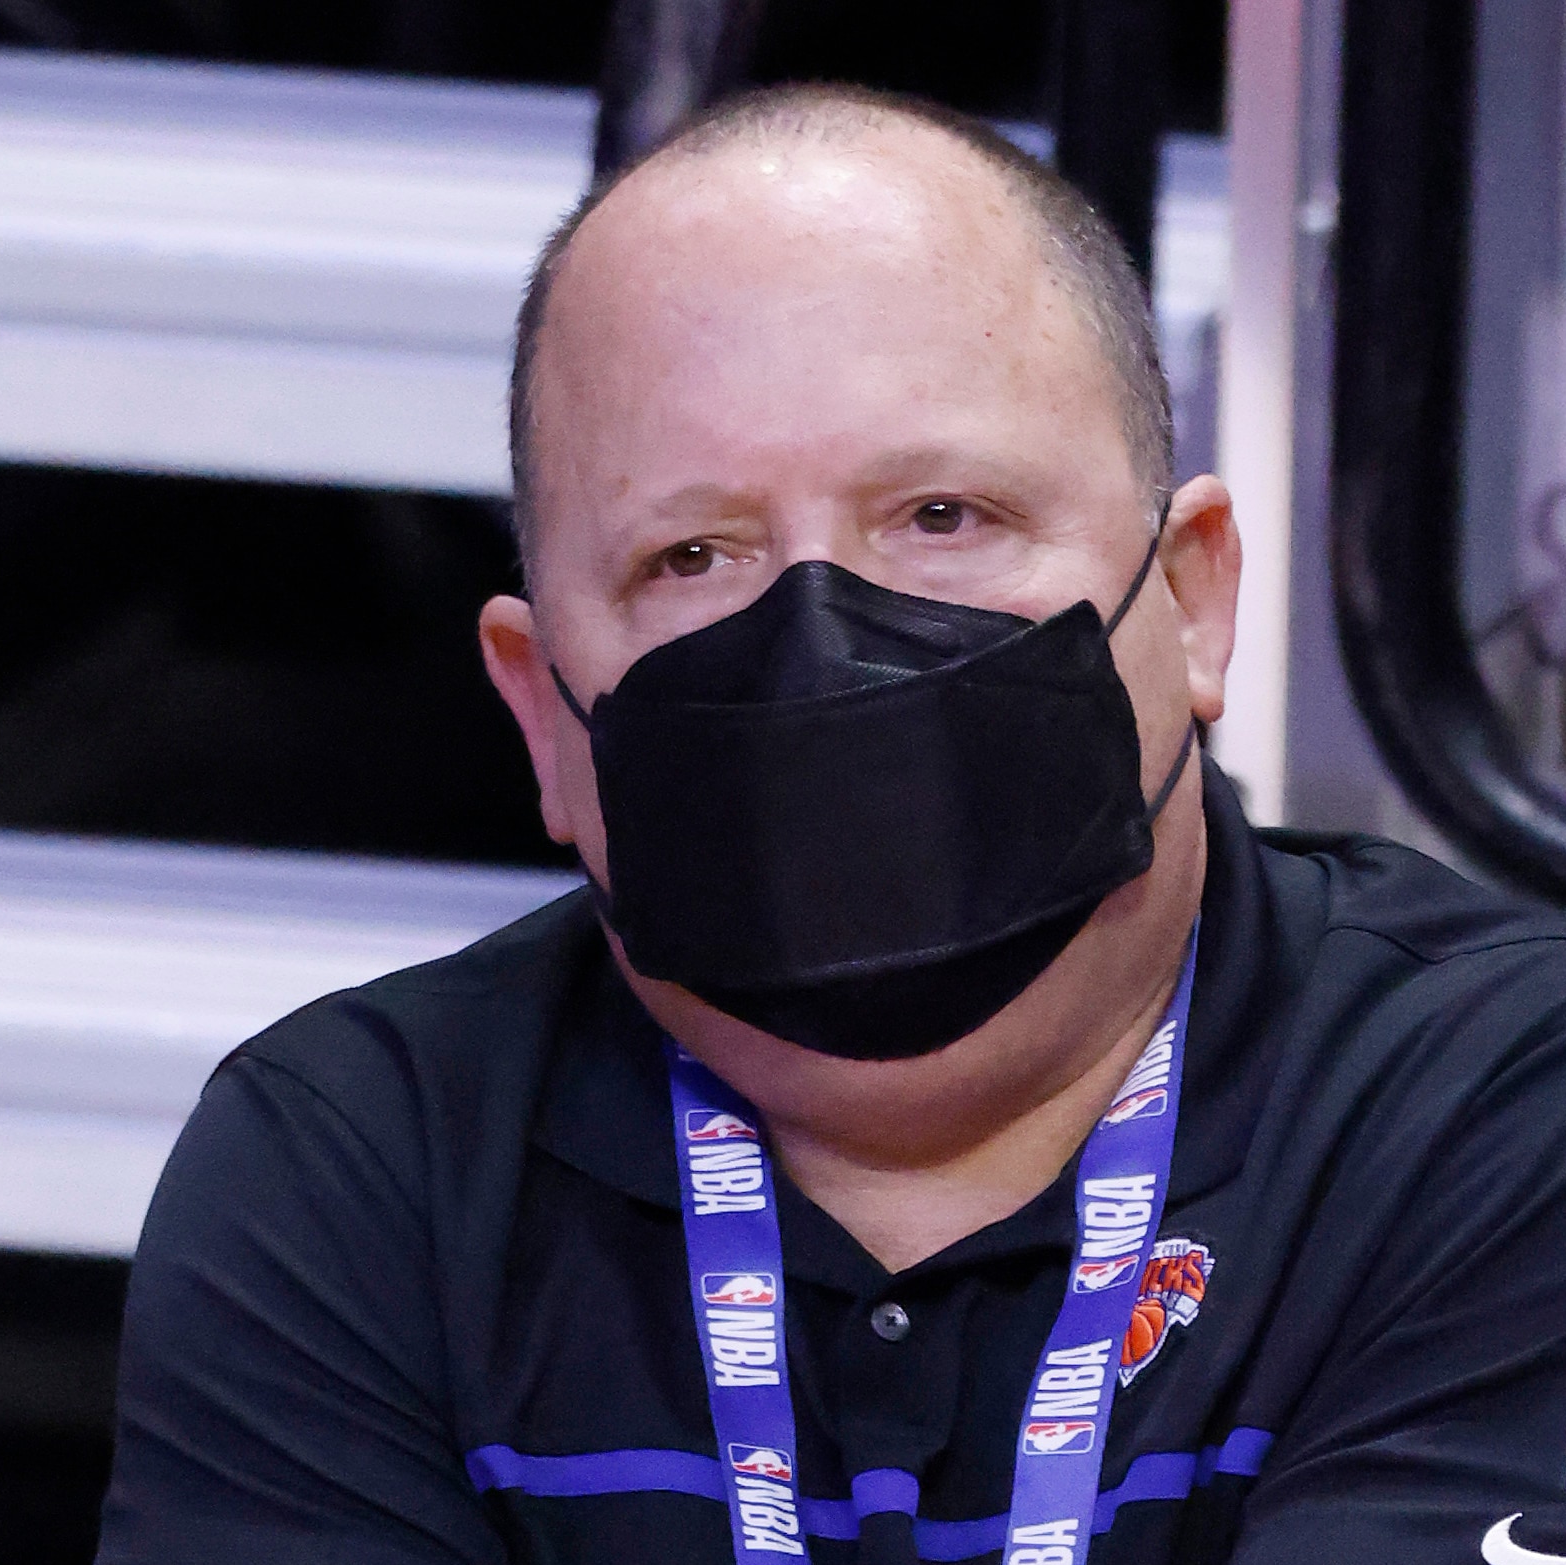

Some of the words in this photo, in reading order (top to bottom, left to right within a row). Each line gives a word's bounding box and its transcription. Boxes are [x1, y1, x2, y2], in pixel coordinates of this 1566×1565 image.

[688, 1142, 766, 1215] NBA
[1080, 1173, 1156, 1258] NBA
[706, 1309, 780, 1387] NBA
[1030, 1338, 1113, 1417] NBA
[735, 1475, 804, 1556] NBA
